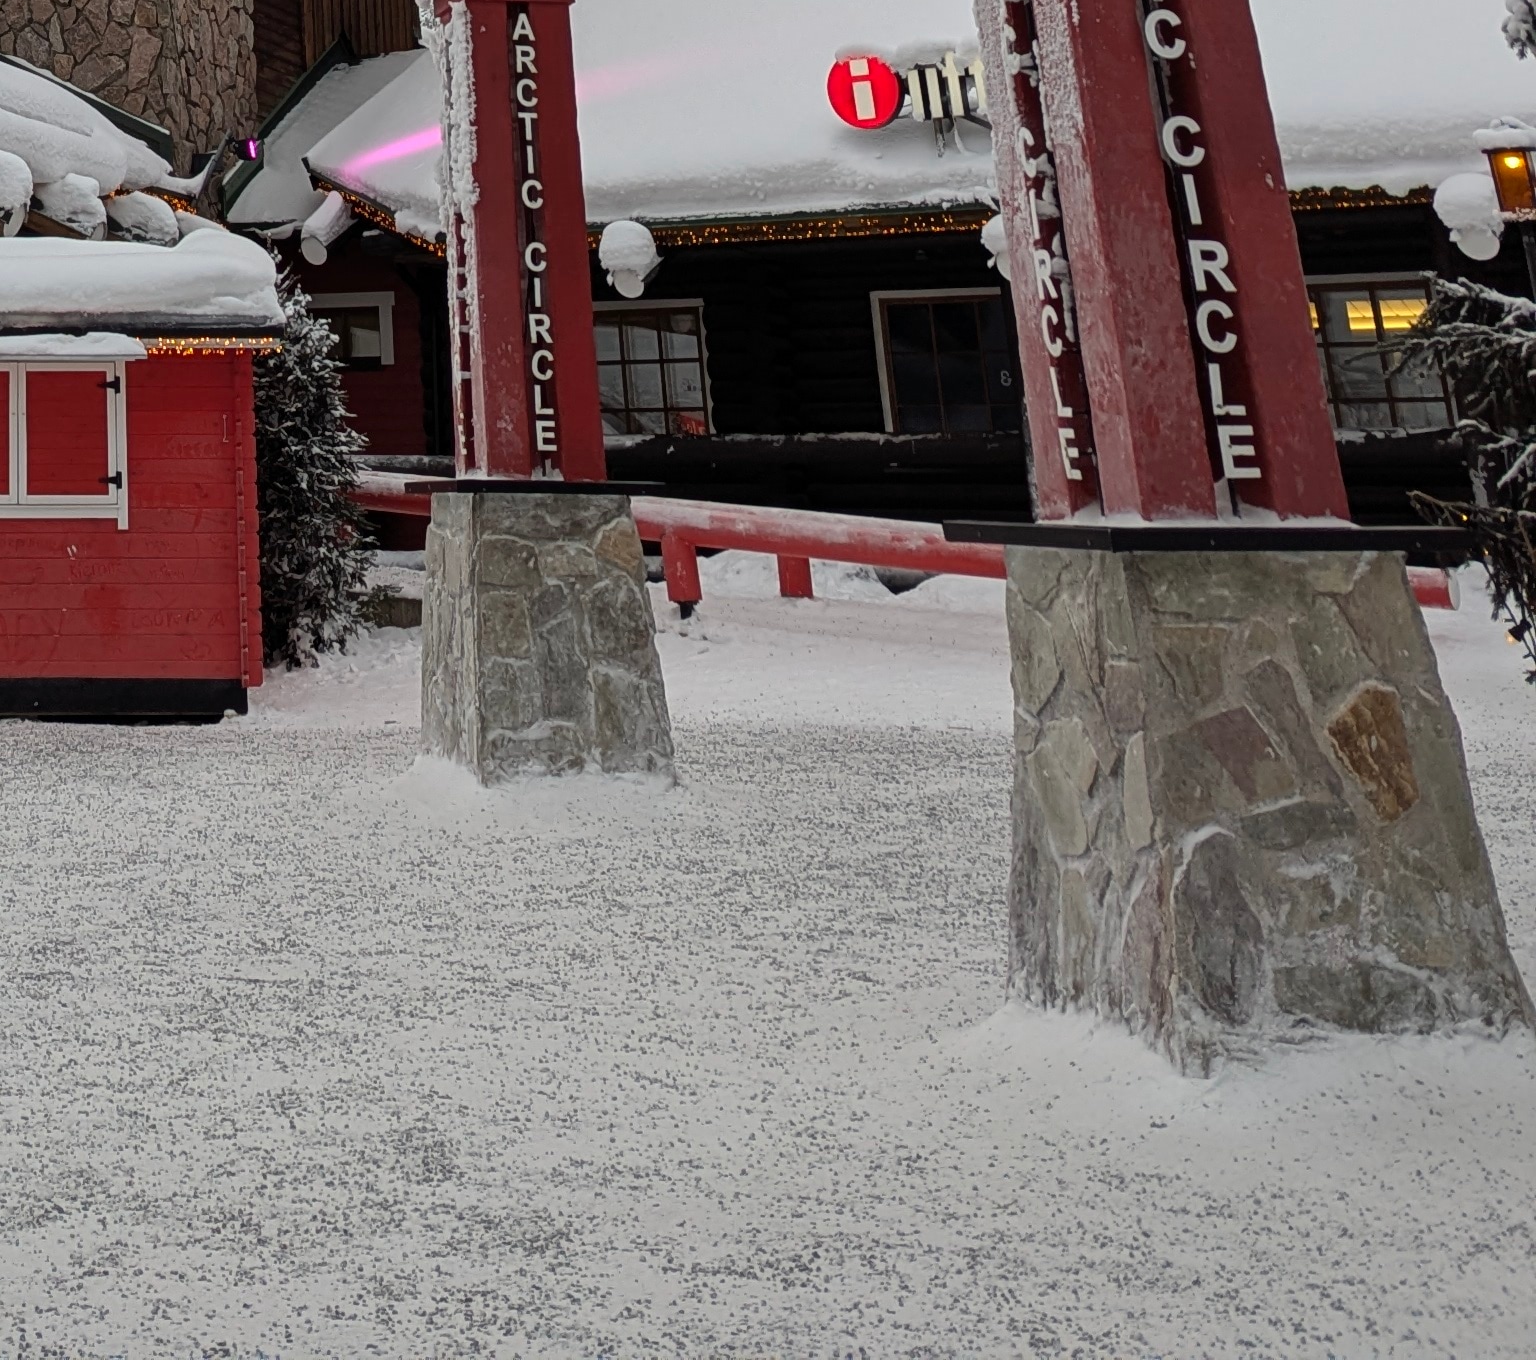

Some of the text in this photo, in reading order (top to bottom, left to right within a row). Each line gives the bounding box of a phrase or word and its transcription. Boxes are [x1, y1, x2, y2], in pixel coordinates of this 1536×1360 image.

[511, 13, 558, 453] ARCTIC CIRCLE
[1017, 126, 1083, 481] CIRCLE
[1161, 116, 1263, 481] CIRCLE
